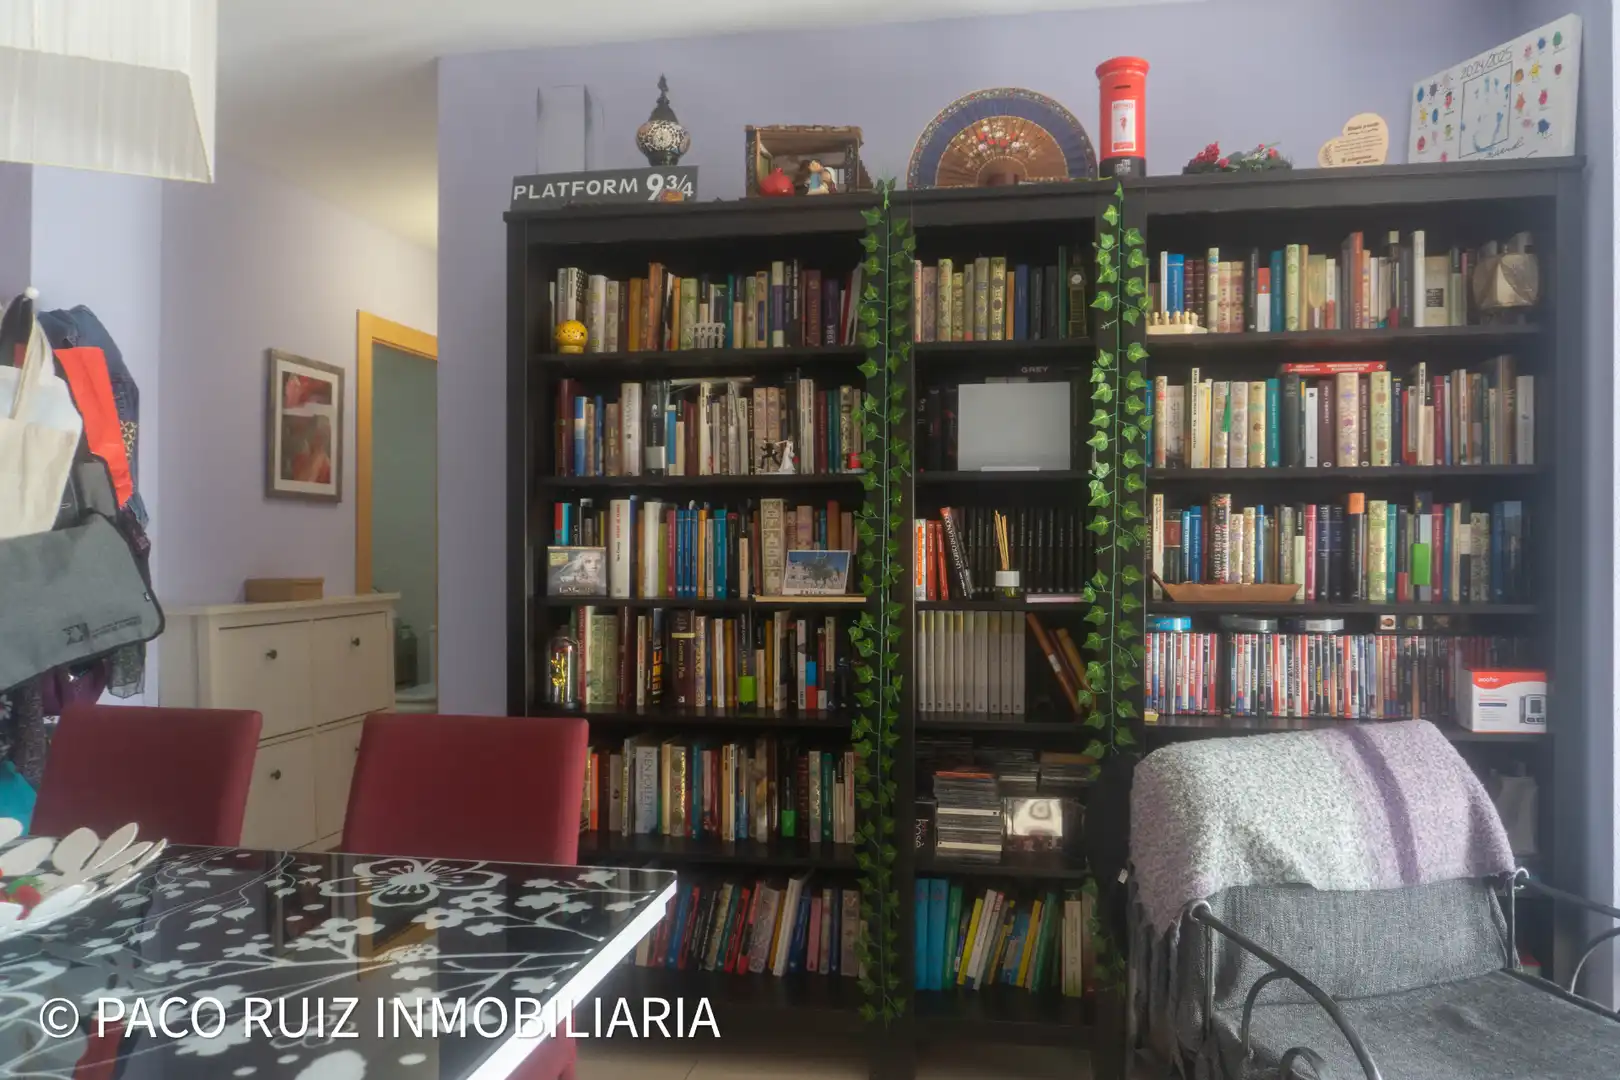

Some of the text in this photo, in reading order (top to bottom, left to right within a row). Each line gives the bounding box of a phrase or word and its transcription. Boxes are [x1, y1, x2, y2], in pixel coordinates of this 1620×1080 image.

[513, 178, 638, 200] PLATFORM
[827, 324, 836, 345] 1984
[645, 750, 655, 814] KEN FOLLETT
